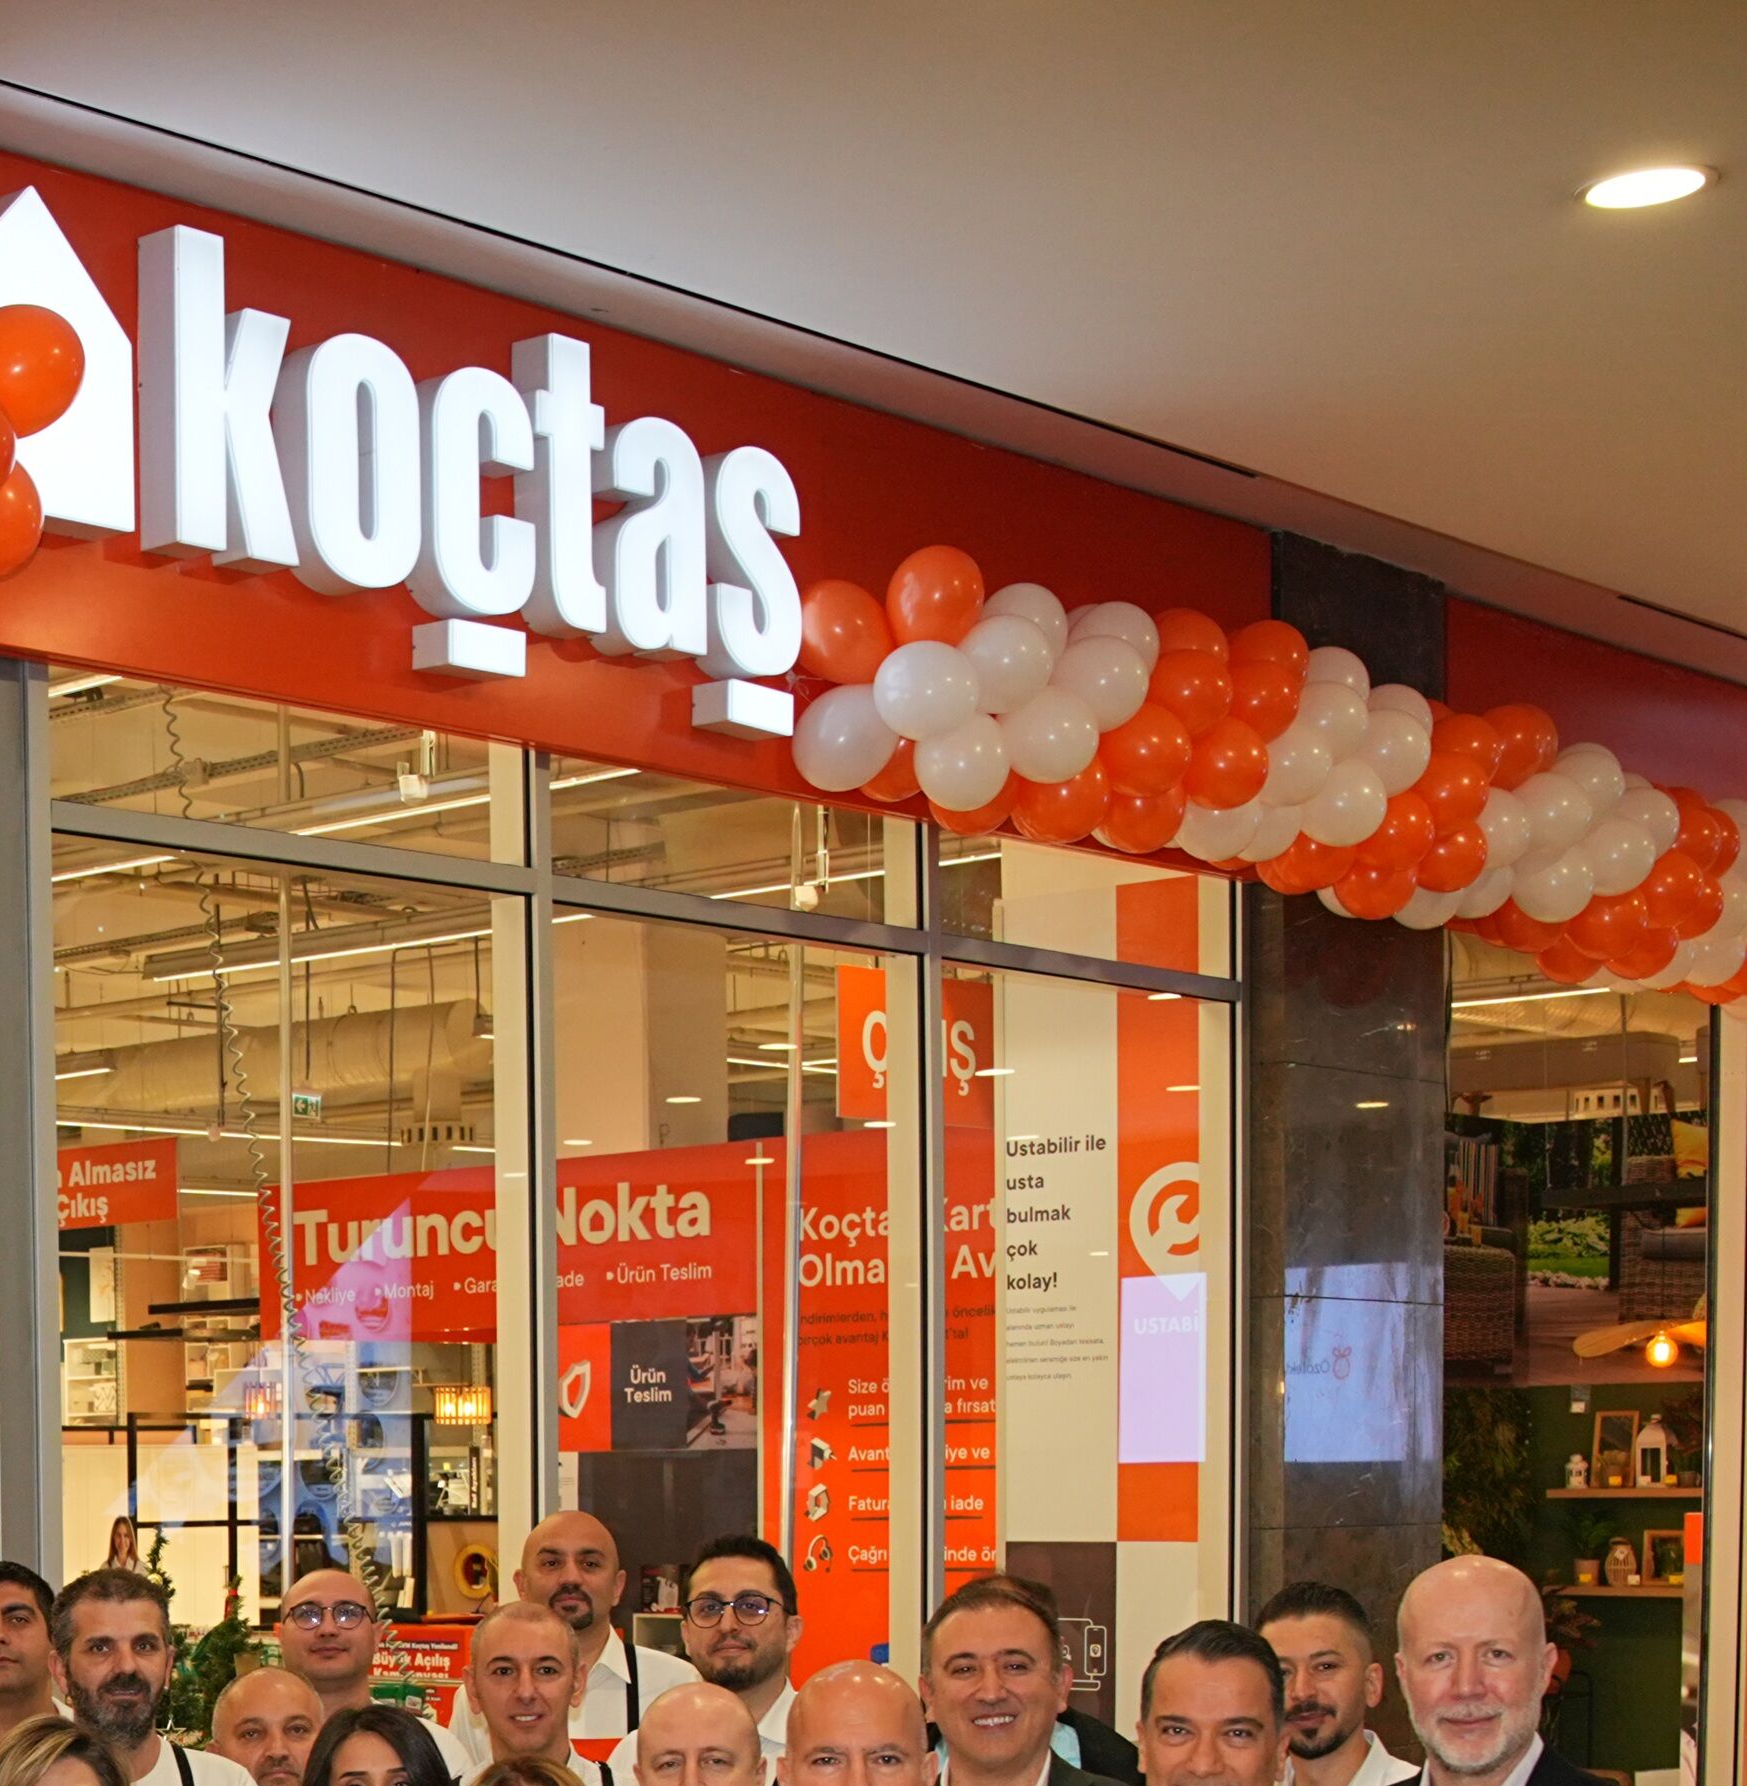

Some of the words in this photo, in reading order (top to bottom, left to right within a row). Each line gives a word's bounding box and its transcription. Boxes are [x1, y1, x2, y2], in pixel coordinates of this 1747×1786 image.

[138, 224, 803, 740] koçtaş
[863, 1010, 976, 1096] ÇIŞ
[1005, 1136, 1081, 1157] Ustabilir
[1085, 1135, 1107, 1151] ile
[68, 1160, 157, 1188] Almasız
[1006, 1175, 1044, 1190] usta
[57, 1193, 109, 1227] Çıkış
[1006, 1204, 1071, 1223] bulmak
[800, 1206, 889, 1247] Koçta
[1006, 1240, 1038, 1261] çok
[799, 1253, 885, 1287] Olma
[305, 1289, 356, 1305] Nakliye
[384, 1281, 434, 1299] Montaj
[556, 1270, 584, 1288] ade
[617, 1262, 656, 1284] Ürün
[660, 1262, 712, 1281] Teslim
[1006, 1272, 1058, 1292] kolay!
[800, 1311, 877, 1325] ndirimlerden,
[630, 1364, 666, 1384] Ürün
[624, 1387, 672, 1403] Teslim
[848, 1379, 877, 1394] Size
[970, 1379, 989, 1390] ve
[848, 1404, 885, 1420] puan
[957, 1398, 996, 1413] fırsat
[971, 1448, 990, 1459] ve
[951, 1496, 984, 1511] iade
[848, 1545, 887, 1564] Çağrı
